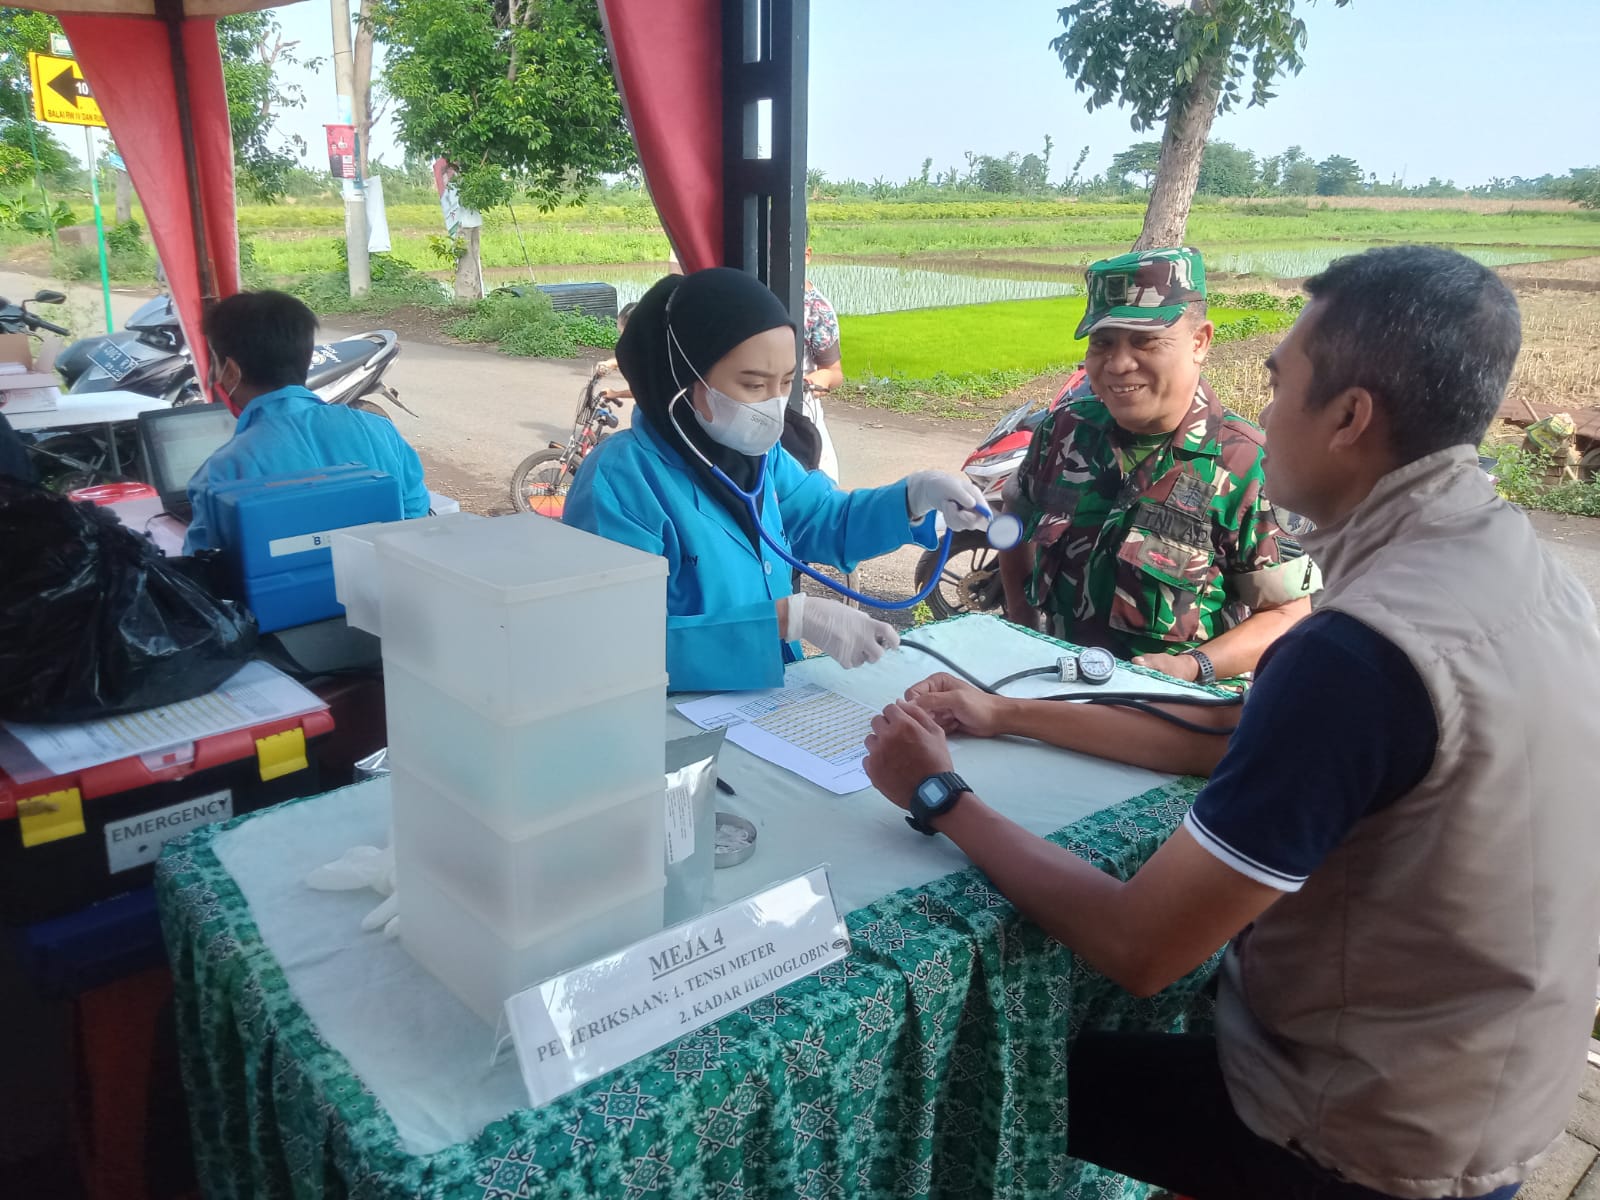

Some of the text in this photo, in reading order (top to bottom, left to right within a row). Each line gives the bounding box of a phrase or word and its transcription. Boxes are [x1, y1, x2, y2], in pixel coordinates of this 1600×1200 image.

[75, 82, 89, 95] 10
[1146, 509, 1208, 545] TNI AD
[112, 797, 229, 843] EMERGENCY
[649, 927, 725, 976] MEJA 4
[685, 963, 726, 992] TENSI
[728, 942, 777, 970] METER
[679, 942, 831, 1024] 2. KADAR HEMOGLOBIN
